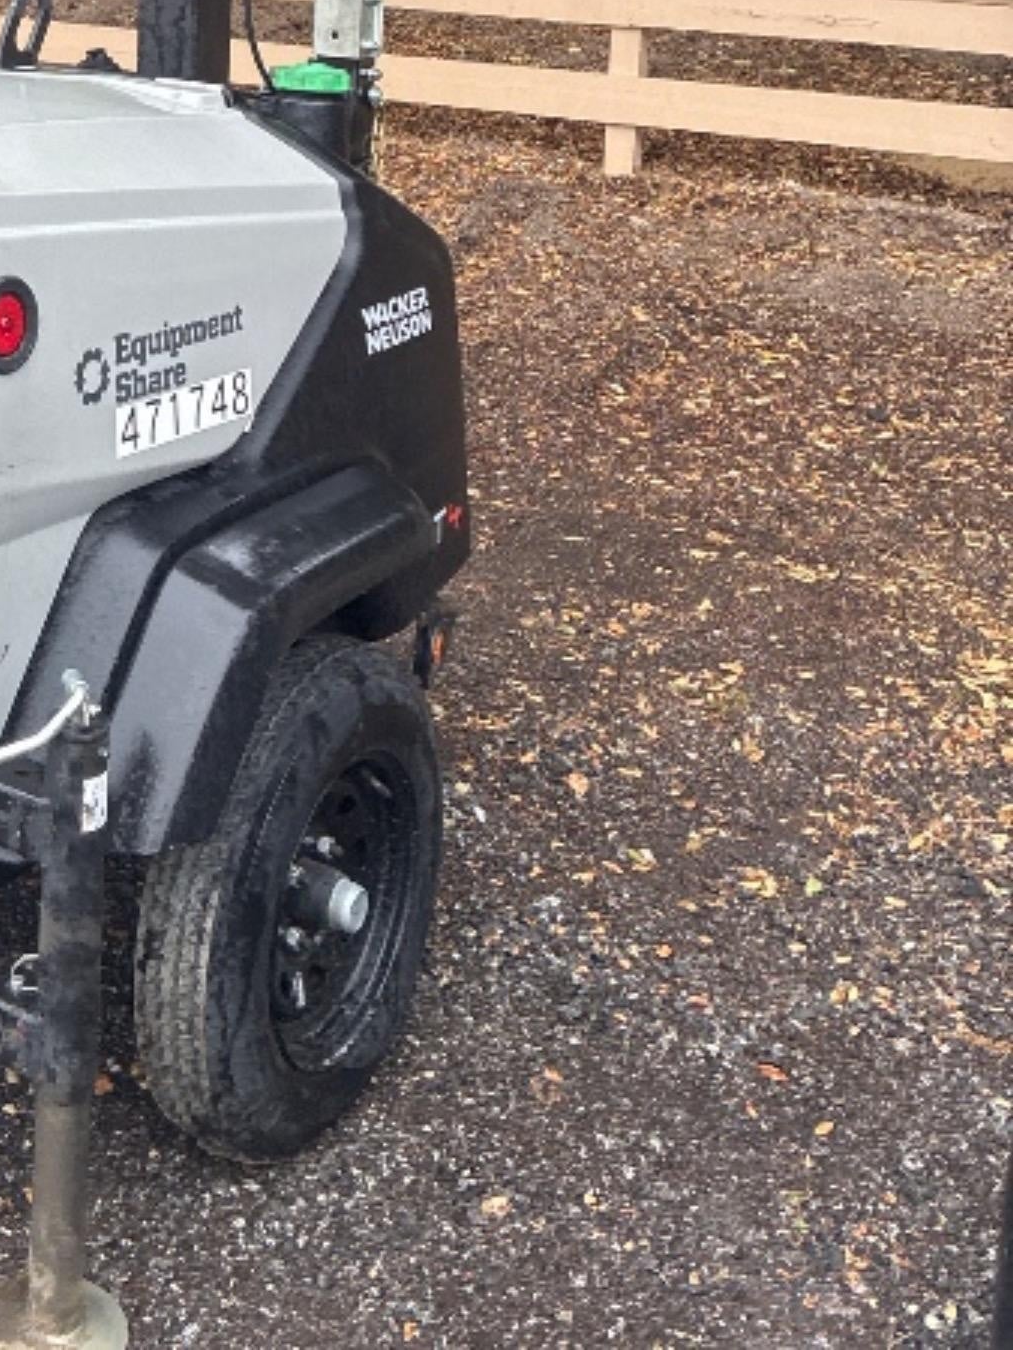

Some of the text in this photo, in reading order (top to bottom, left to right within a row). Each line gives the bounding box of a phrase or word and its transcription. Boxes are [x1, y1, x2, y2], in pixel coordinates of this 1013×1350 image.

[361, 287, 429, 330] WACKER
[364, 308, 432, 356] NEUSON
[113, 305, 243, 367] Equipment
[114, 361, 187, 404] Share
[120, 370, 250, 449] 471748
